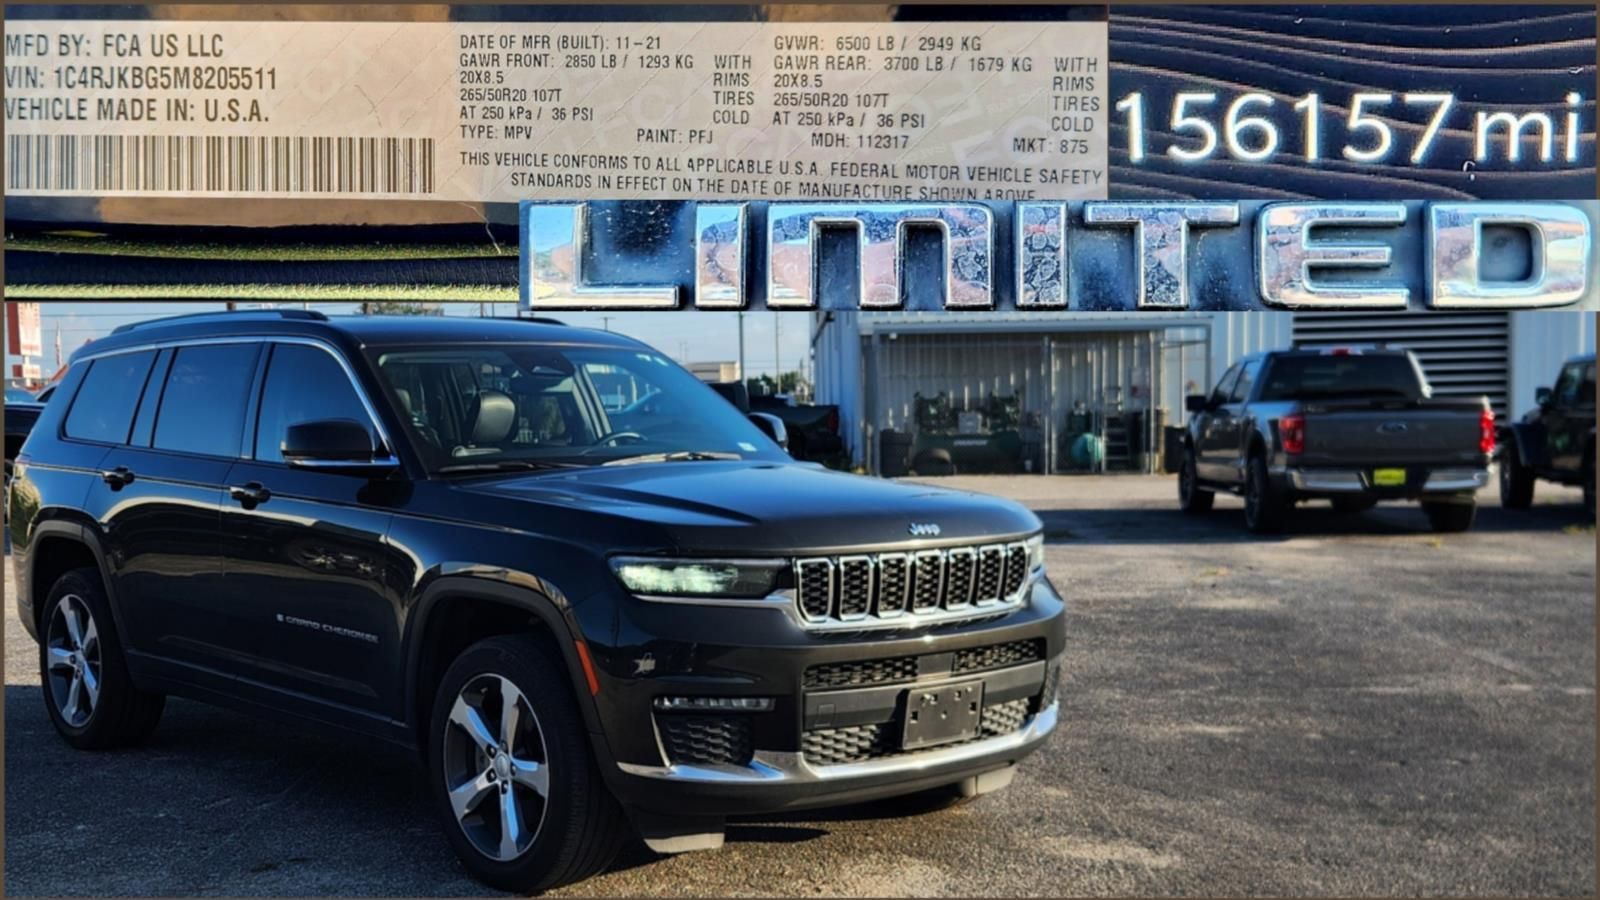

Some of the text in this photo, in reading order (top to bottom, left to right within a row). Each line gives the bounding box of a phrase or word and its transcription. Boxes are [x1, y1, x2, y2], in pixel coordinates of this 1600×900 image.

[5, 34, 224, 57] MFD BY: FCA US LLC
[460, 35, 494, 49] DATE
[499, 35, 517, 49] OF
[522, 35, 551, 49] MFR
[556, 35, 610, 51] (BUILT):
[774, 36, 982, 51] GVWR: 6500 LB / 2949 KG
[460, 54, 752, 69] GAWR FRONT: 2850 LB / 1293 KG WITH
[774, 55, 1097, 73] GAWR REAR: 3700 LB / 1679 KG WITH
[5, 67, 277, 90] VIN: 1C4RJKBG5M8205511
[460, 71, 750, 87] 20X8.5 RIMS
[774, 74, 1095, 92] 20X8.5 RIMS
[460, 89, 755, 105] 265/50R20 107T TIRES
[773, 93, 1100, 112] 265/50R20 107T TIRES
[5, 98, 88, 121] VEHICLE
[97, 98, 157, 121] MADE
[166, 98, 195, 121] IN:
[460, 106, 750, 125] AT 250 kPa / 36 PSI COLD
[772, 111, 1093, 132] AT 250 kPa / 36 PSI COLD
[1115, 92, 1581, 163] 156157 mi
[460, 125, 1089, 154] TYPE: MPV PAINT: PFJ MDH: 112317 MKT: 875
[460, 152, 490, 166] THIS
[495, 153, 549, 167] VEHICLE
[553, 154, 628, 170] CONFORMS
[633, 156, 650, 170] TO
[656, 157, 682, 172] ALL
[687, 158, 773, 174] APPLICABLE
[830, 162, 899, 179] FEDERAL
[906, 164, 960, 181] MOTOR
[967, 166, 1032, 183] VEHICLE
[1039, 169, 1102, 185] SAFETY
[511, 172, 592, 189] STANDARDS
[598, 174, 611, 189] IN
[616, 175, 667, 191] EFFECT
[672, 176, 692, 192] ON
[698, 178, 725, 193] THE
[731, 180, 768, 195] DATE
[774, 182, 792, 196] OF
[800, 182, 912, 199] MANUFACTURE
[919, 186, 977, 200] SHOWN
[526, 200, 1596, 308] LIMITED
[908, 522, 940, 536] Jeep
